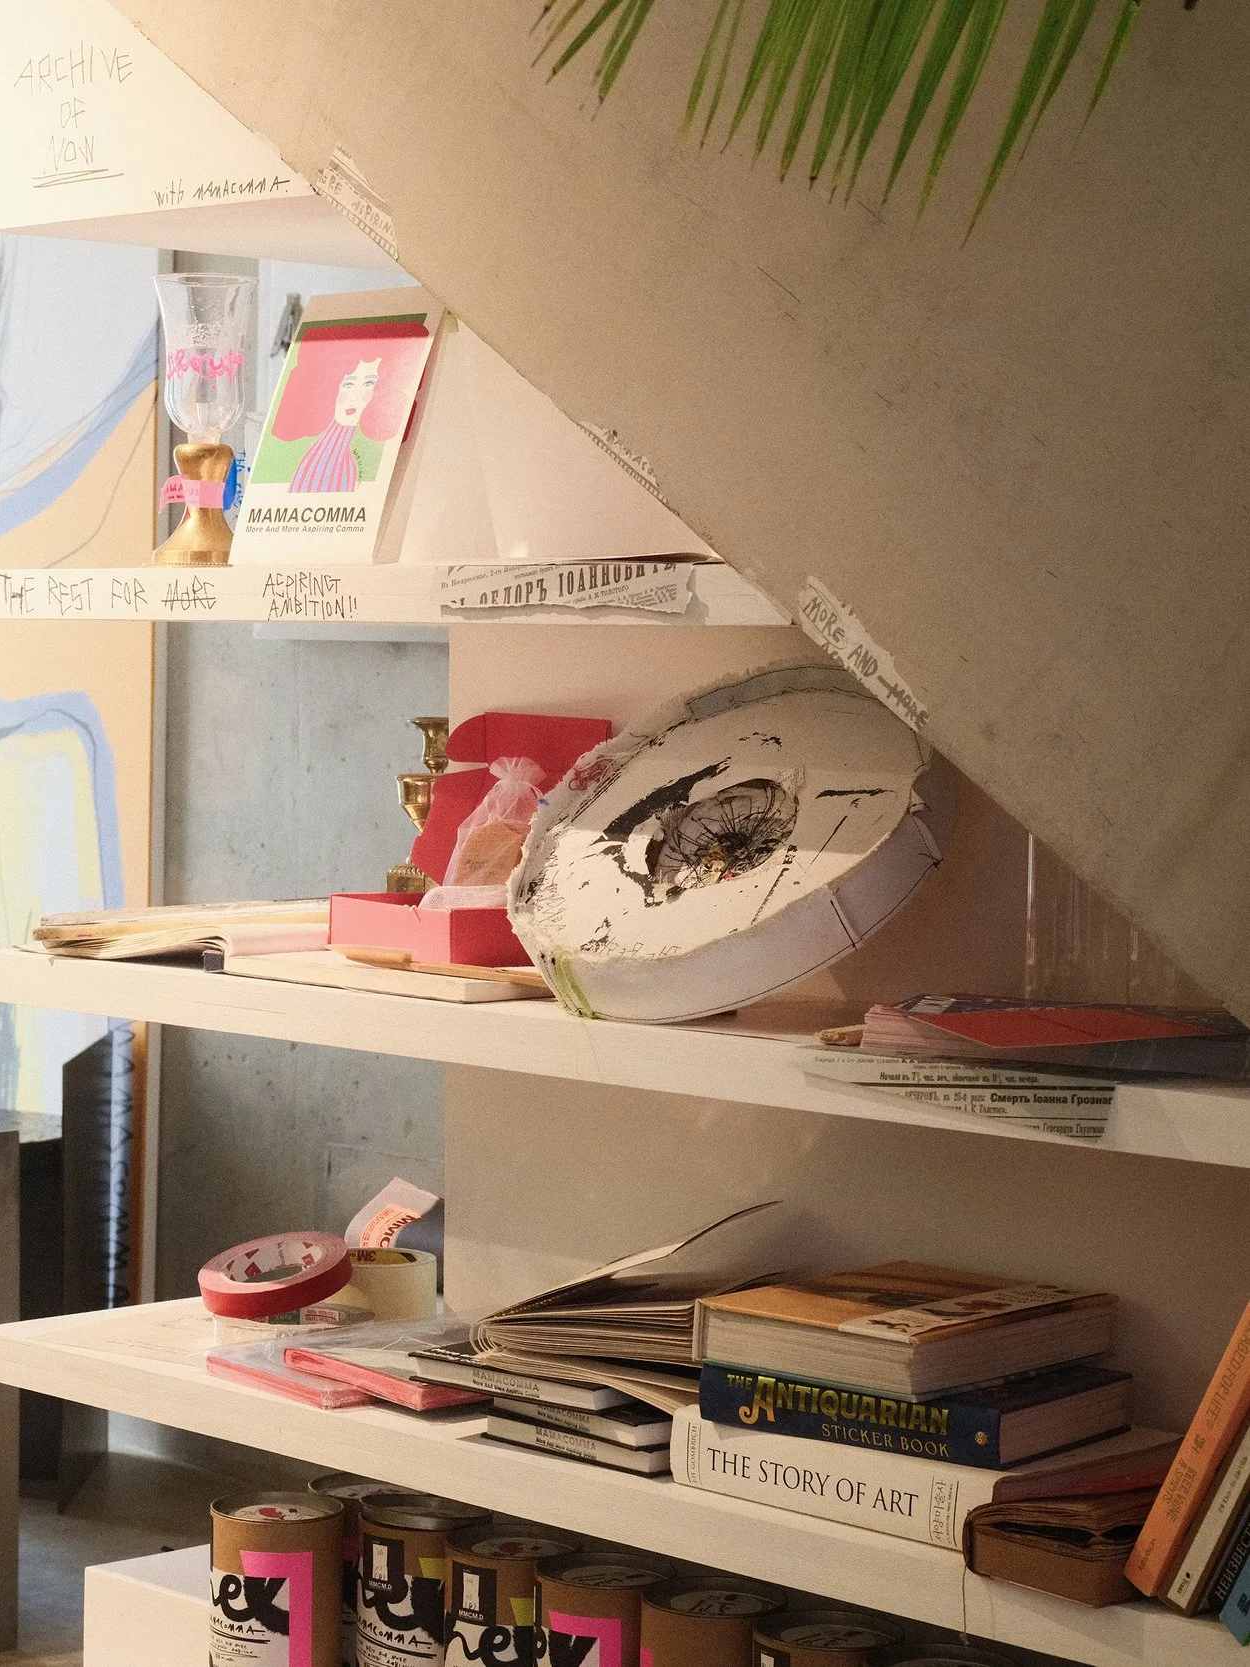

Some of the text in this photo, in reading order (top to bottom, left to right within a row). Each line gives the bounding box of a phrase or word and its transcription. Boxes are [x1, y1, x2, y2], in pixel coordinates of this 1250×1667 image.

[14, 40, 133, 96] ARCHIVE
[60, 97, 86, 129] OF
[44, 136, 95, 175] NOW
[154, 178, 184, 207] with
[245, 524, 364, 535] More And More Aspiring Comma
[248, 506, 367, 524] MAMACOMMA
[48, 576, 94, 616] REST
[111, 577, 148, 613] FOR
[262, 571, 341, 599] ASPIRING
[802, 596, 845, 643] MORE
[847, 643, 879, 677] AND
[990, 1092, 1030, 1105] Смерть
[472, 1369, 540, 1392] MAMACOMMA
[1220, 1367, 1236, 1395] FOR
[727, 1373, 950, 1435] THE ANTIQUARIAN
[535, 1426, 597, 1451] MAMACOMMA
[690, 1425, 698, 1470] GOMBRICH
[821, 1422, 950, 1458] STICKER BOOK
[707, 1446, 751, 1481] THE
[758, 1457, 831, 1497] STORY
[835, 1475, 867, 1503] OF
[872, 1485, 920, 1518] ART
[1162, 1467, 1185, 1504] SPIRITS
[932, 1479, 947, 1542] 서양미술사
[1167, 1493, 1187, 1523] WINE
